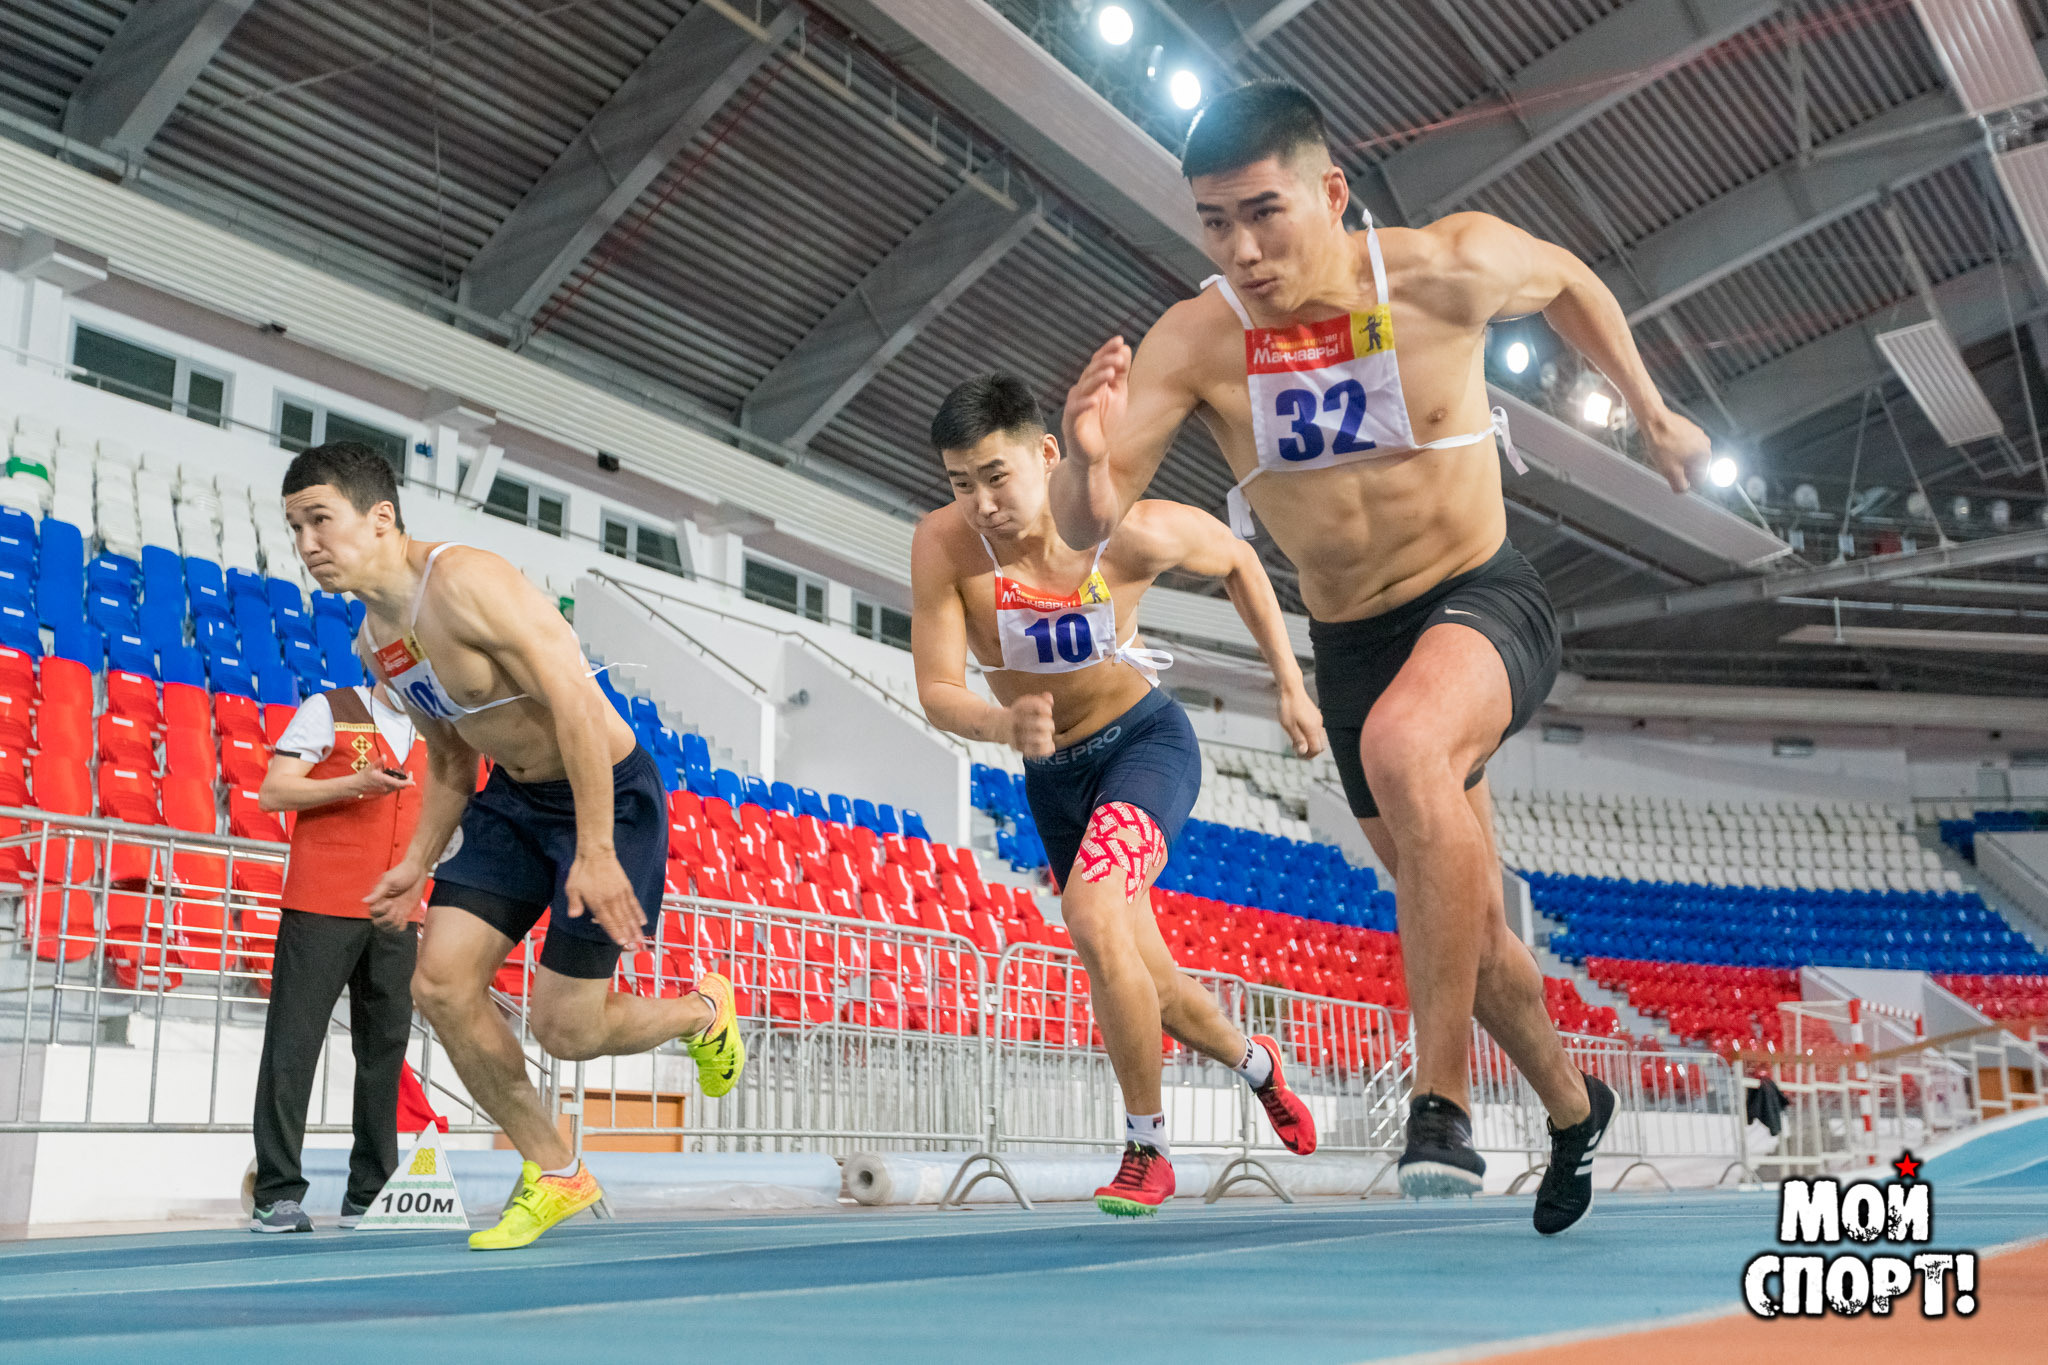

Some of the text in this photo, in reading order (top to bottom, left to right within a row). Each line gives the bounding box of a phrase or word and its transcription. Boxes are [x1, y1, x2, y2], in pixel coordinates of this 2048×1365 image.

[1253, 342, 1339, 364] Манчаары
[1275, 378, 1377, 462] 32
[1024, 612, 1093, 664] 10
[1071, 725, 1122, 762] PRO
